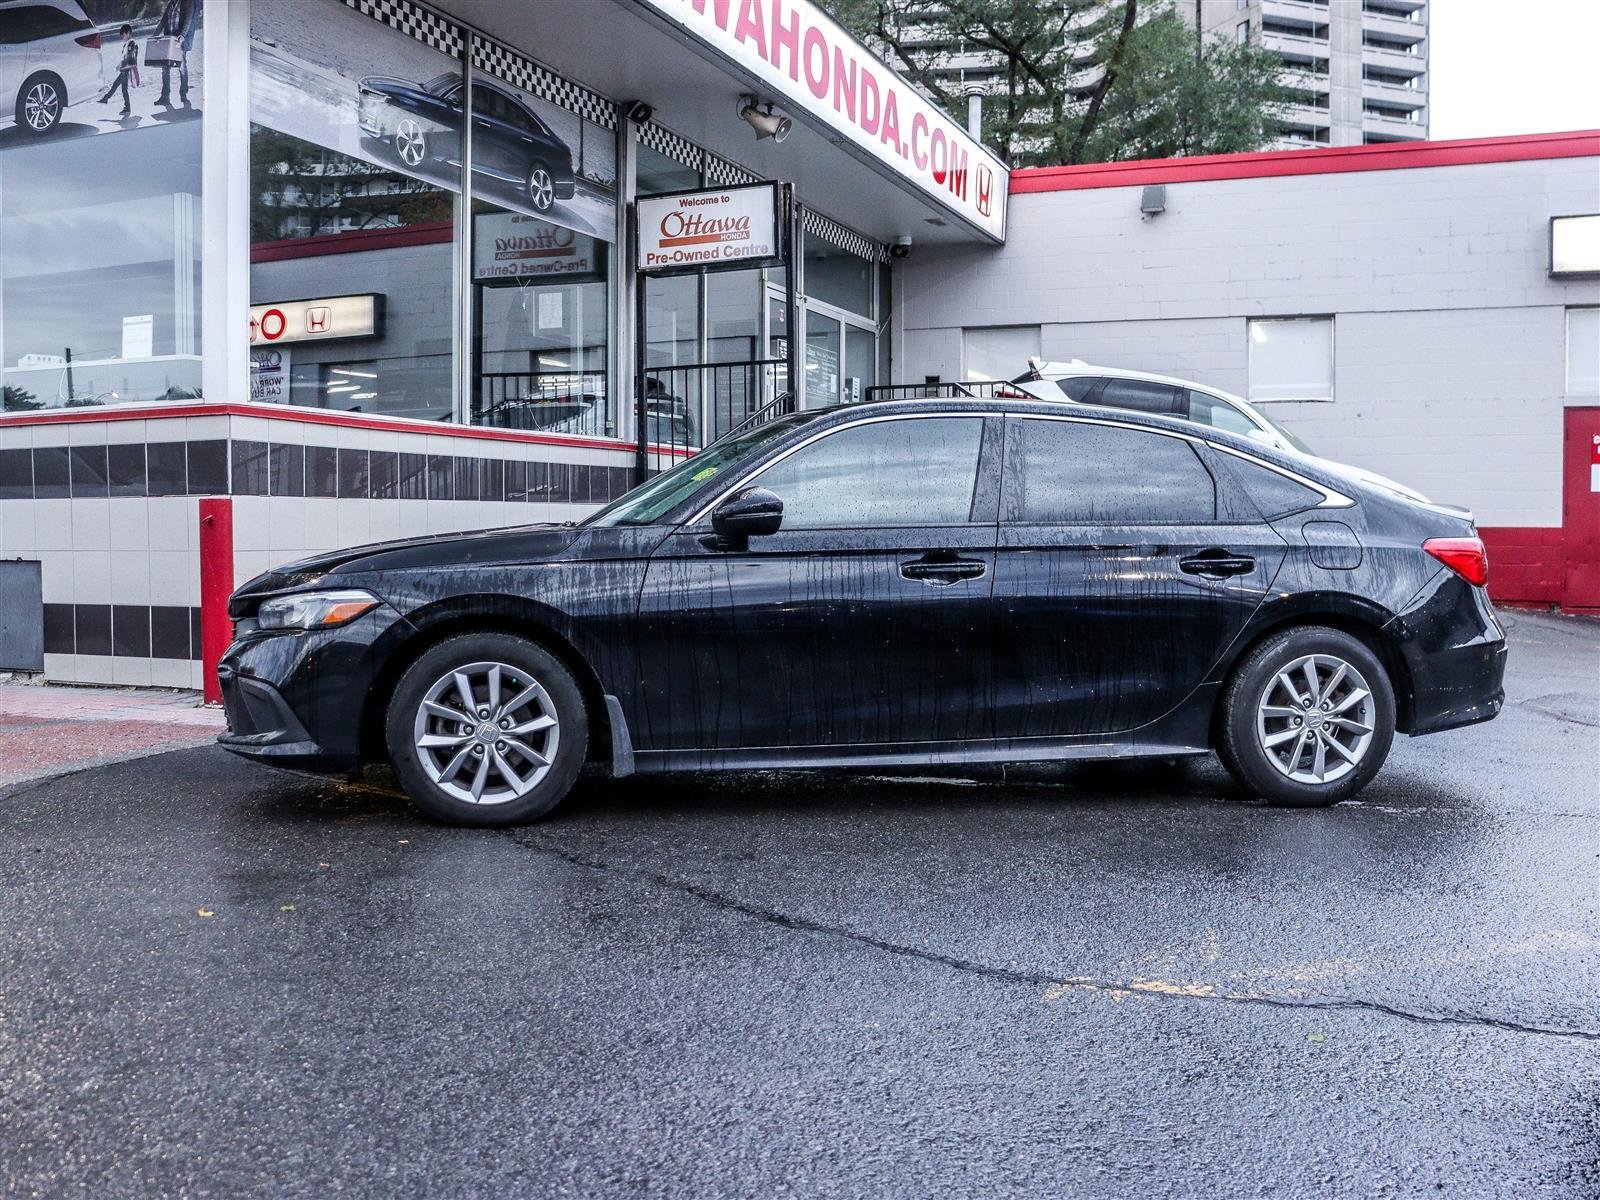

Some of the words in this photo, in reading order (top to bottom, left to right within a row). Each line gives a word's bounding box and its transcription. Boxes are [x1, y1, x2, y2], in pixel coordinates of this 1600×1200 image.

[680, 197, 718, 208] Welcome
[721, 195, 730, 203] to
[660, 211, 750, 238] Ottawa
[720, 231, 748, 241] HONDA
[647, 247, 719, 265] Pre-Owned
[723, 243, 768, 257] Centre
